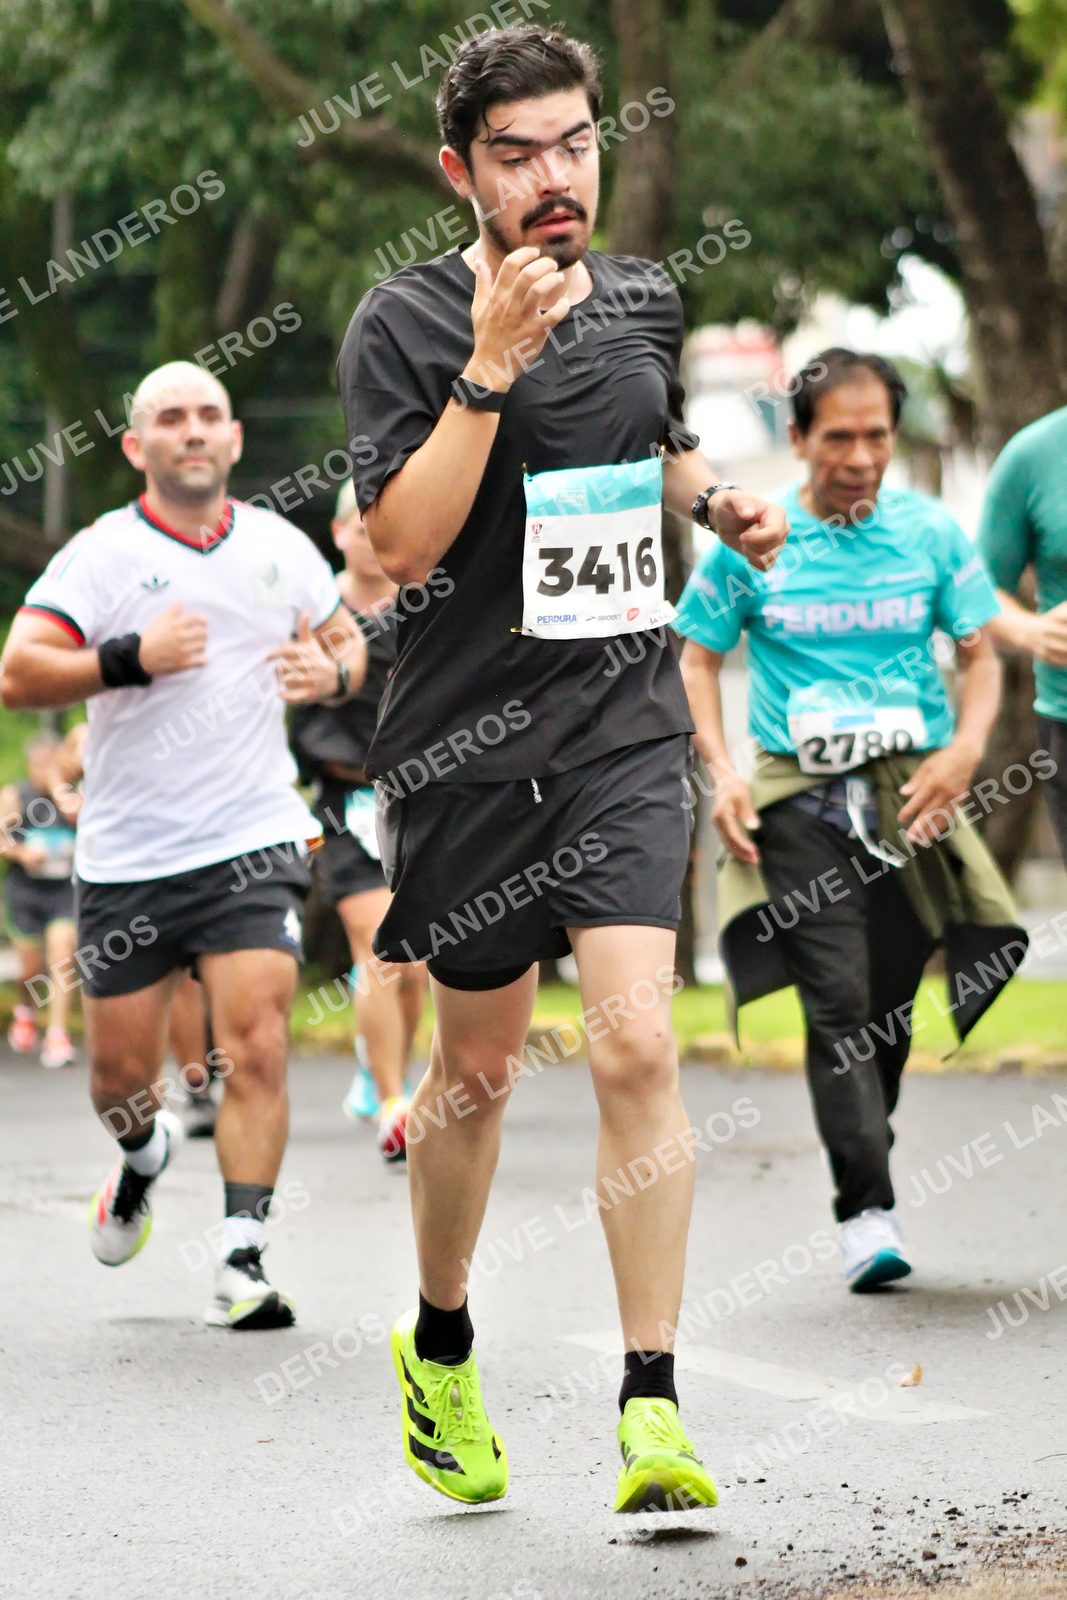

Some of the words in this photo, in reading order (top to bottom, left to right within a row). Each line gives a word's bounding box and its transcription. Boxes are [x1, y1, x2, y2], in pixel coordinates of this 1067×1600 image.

[536, 537, 657, 597] 3416
[537, 614, 577, 623] PERDURA
[761, 592, 928, 633] PERDURA
[803, 729, 913, 765] 2780
